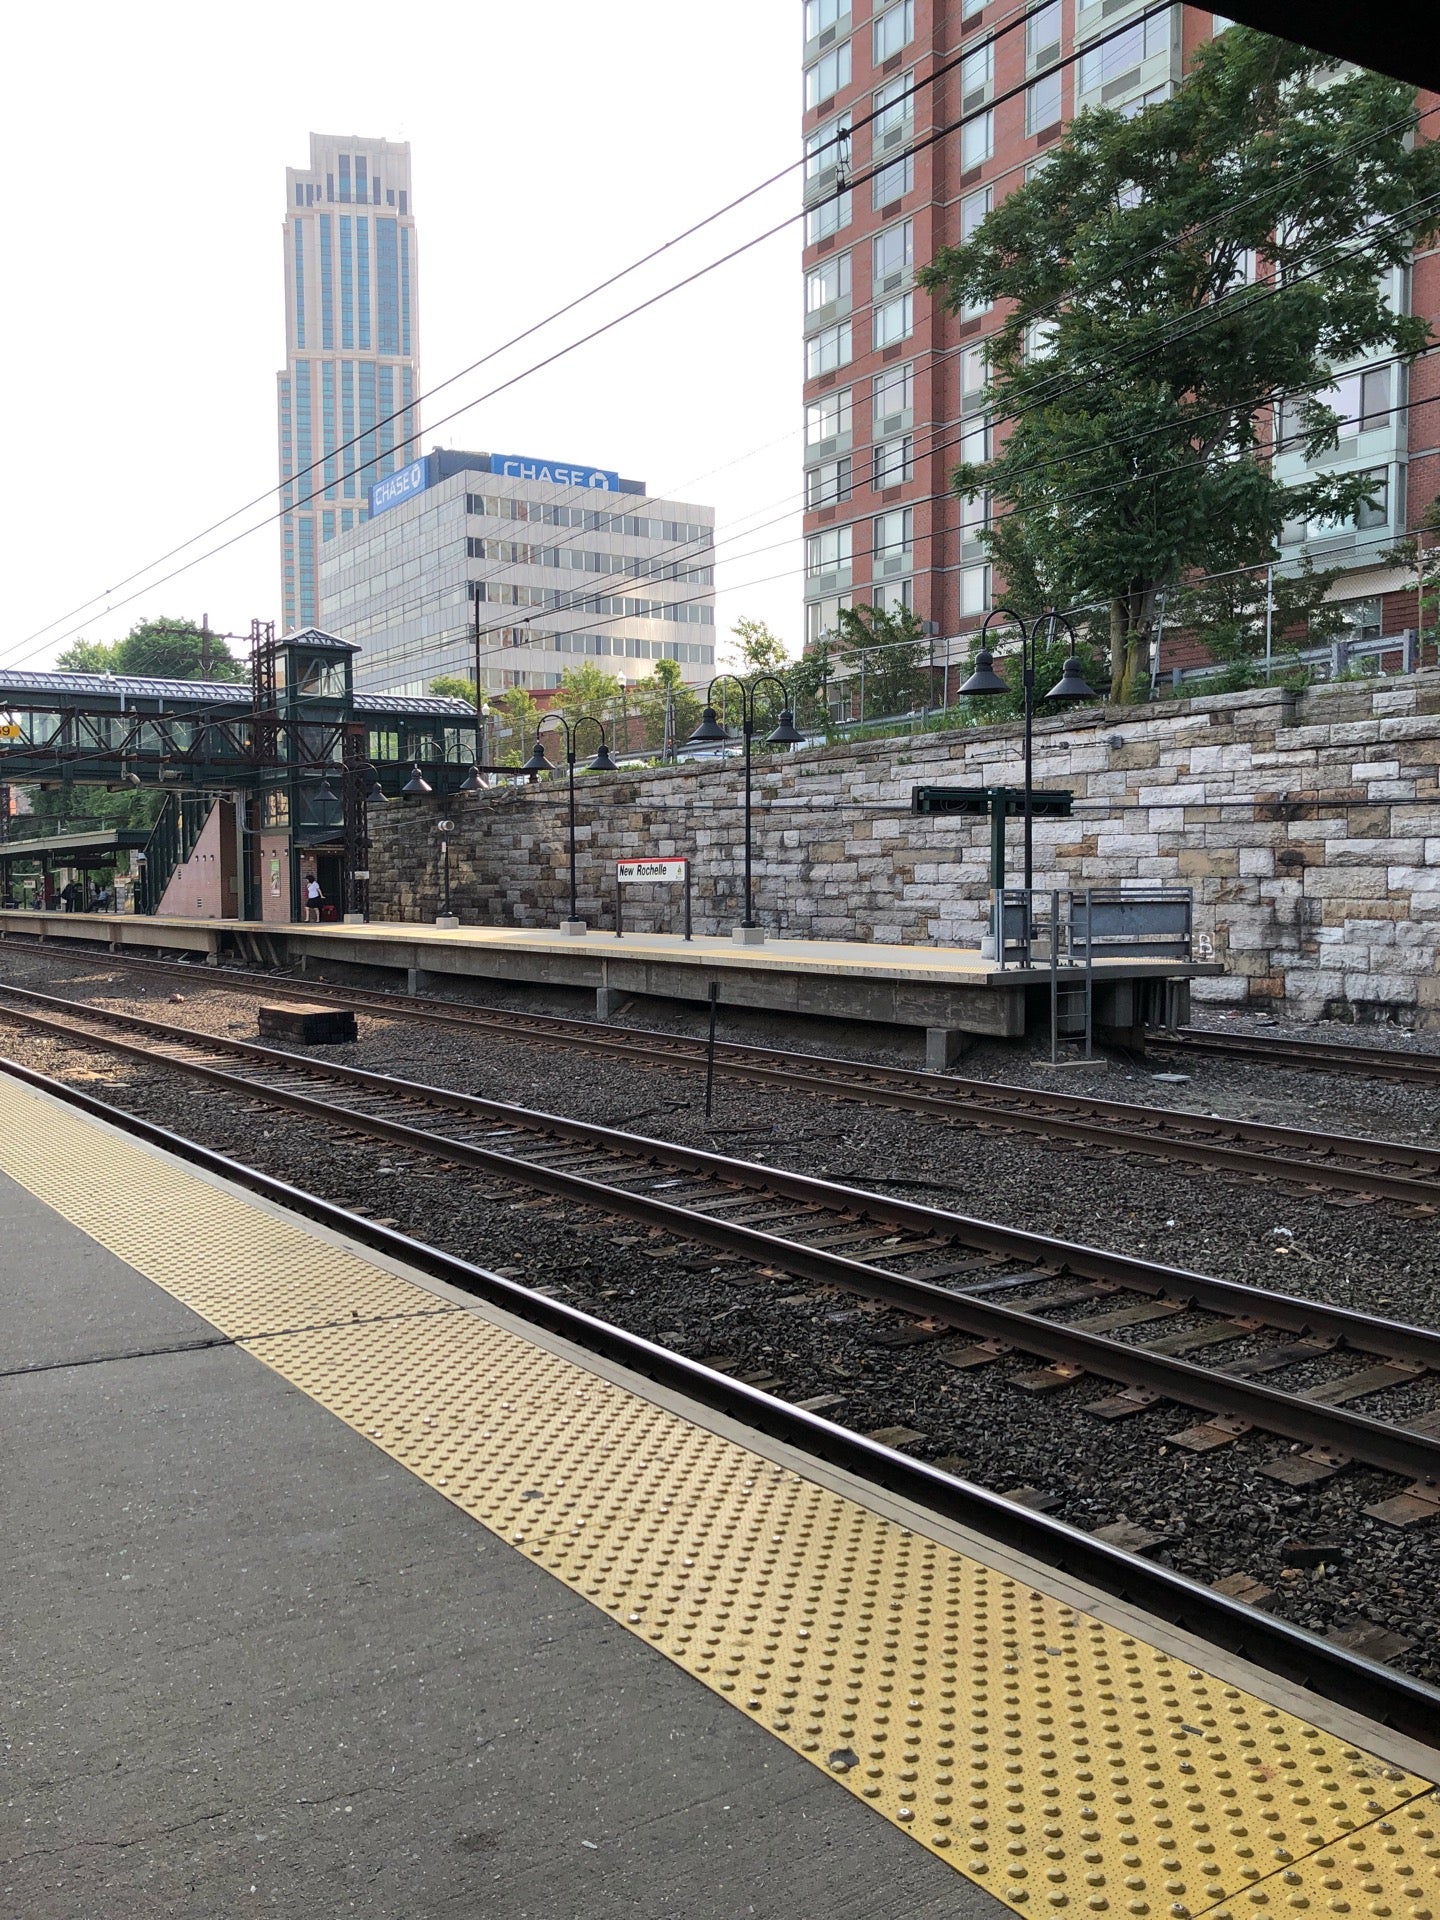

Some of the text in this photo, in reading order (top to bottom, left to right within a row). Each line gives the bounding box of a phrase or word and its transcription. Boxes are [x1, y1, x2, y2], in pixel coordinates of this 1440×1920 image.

[503, 461, 584, 486] CHASE
[375, 472, 410, 506] CHASE
[619, 864, 667, 877] New Rochelle
